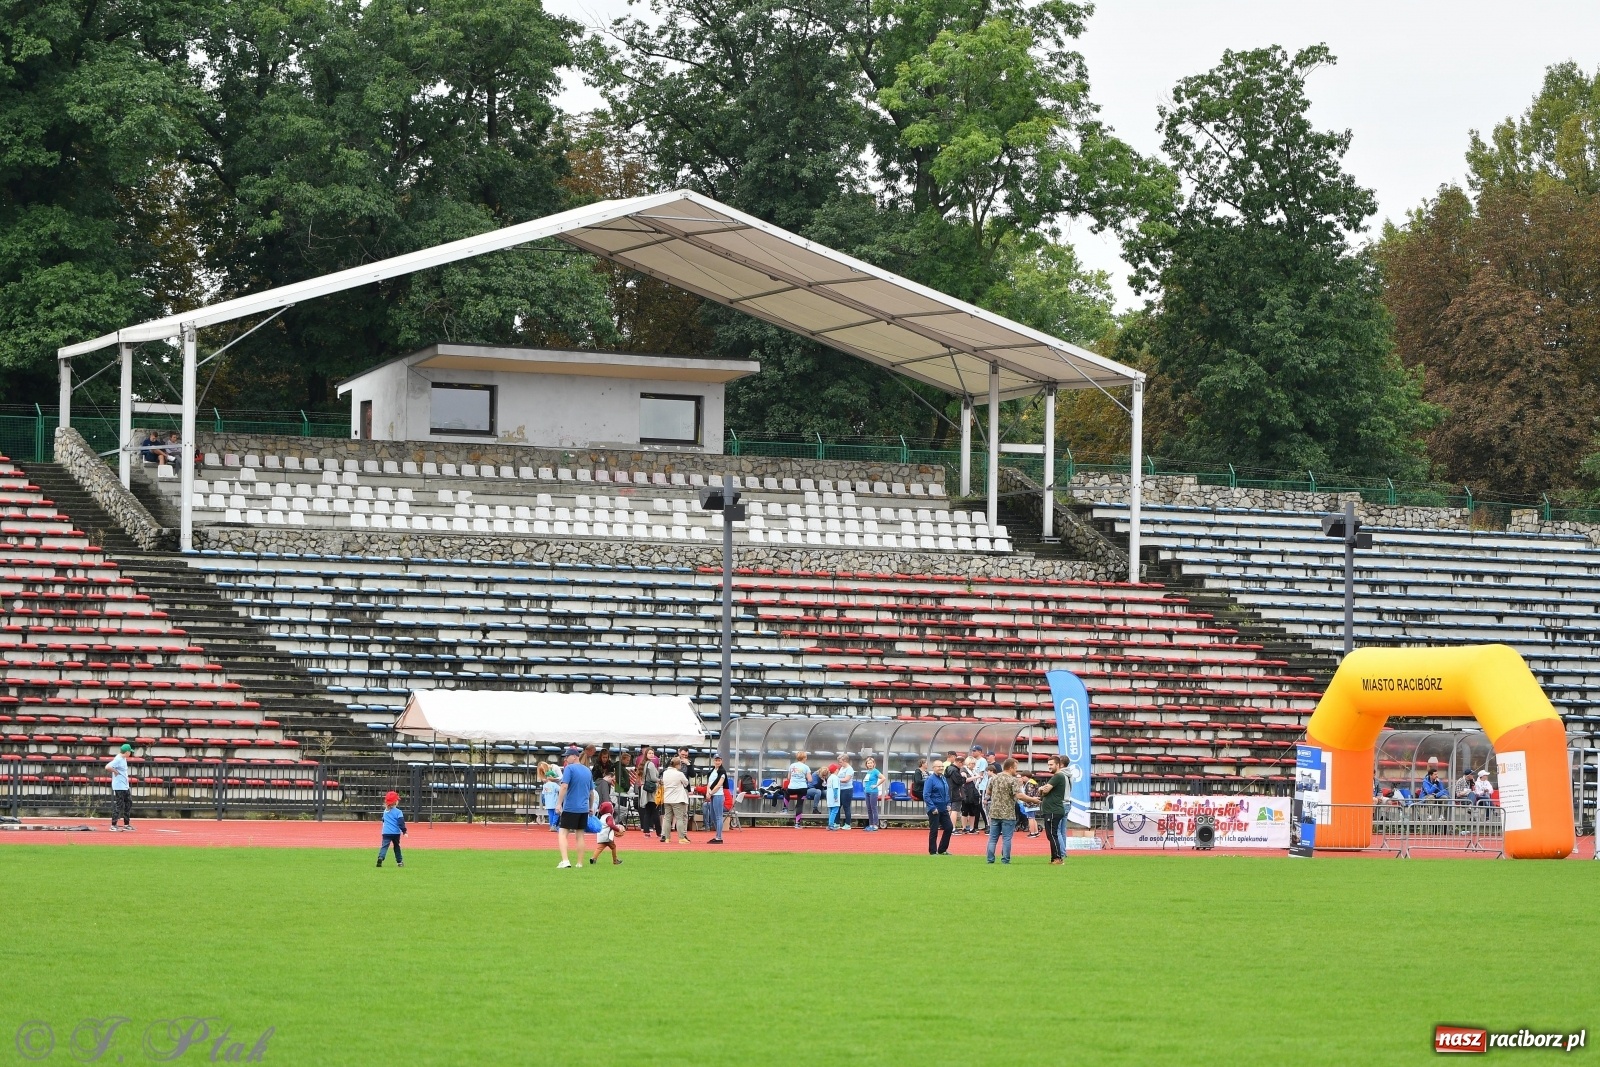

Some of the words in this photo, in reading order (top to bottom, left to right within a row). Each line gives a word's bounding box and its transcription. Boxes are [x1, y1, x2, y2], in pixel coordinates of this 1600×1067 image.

[1362, 678, 1395, 692] MIASTO
[1397, 675, 1442, 691] RACIBÓRZ
[1171, 803, 1236, 817] Raciborski
[1214, 818, 1249, 832] Barier
[1139, 834, 1148, 842] dla
[1228, 834, 1237, 842] ich
